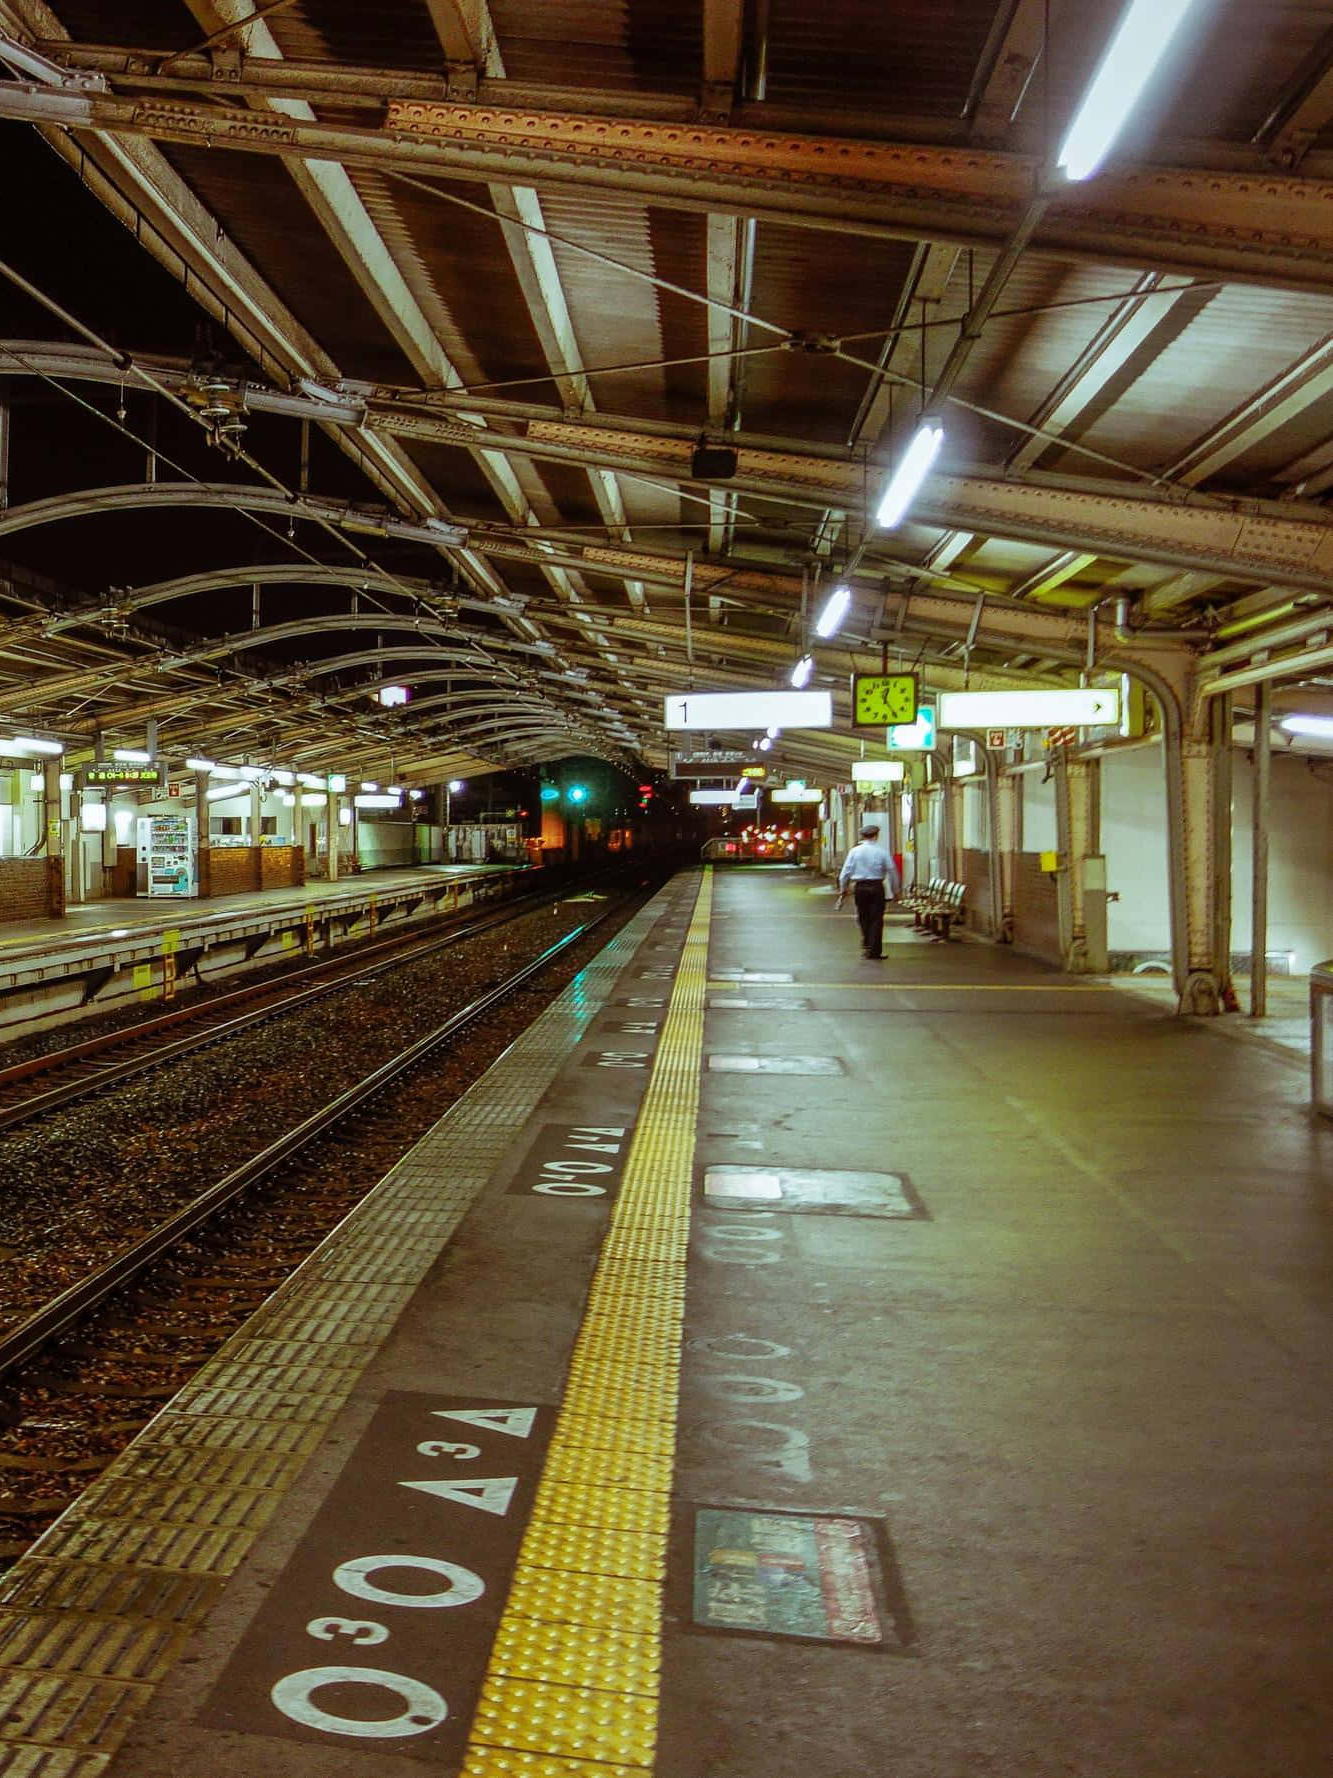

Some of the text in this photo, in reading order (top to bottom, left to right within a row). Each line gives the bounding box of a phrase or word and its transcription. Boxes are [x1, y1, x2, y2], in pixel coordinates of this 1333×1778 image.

[679, 701, 687, 723] 1
[416, 1440, 481, 1460] 3
[306, 1616, 390, 1645] 3
